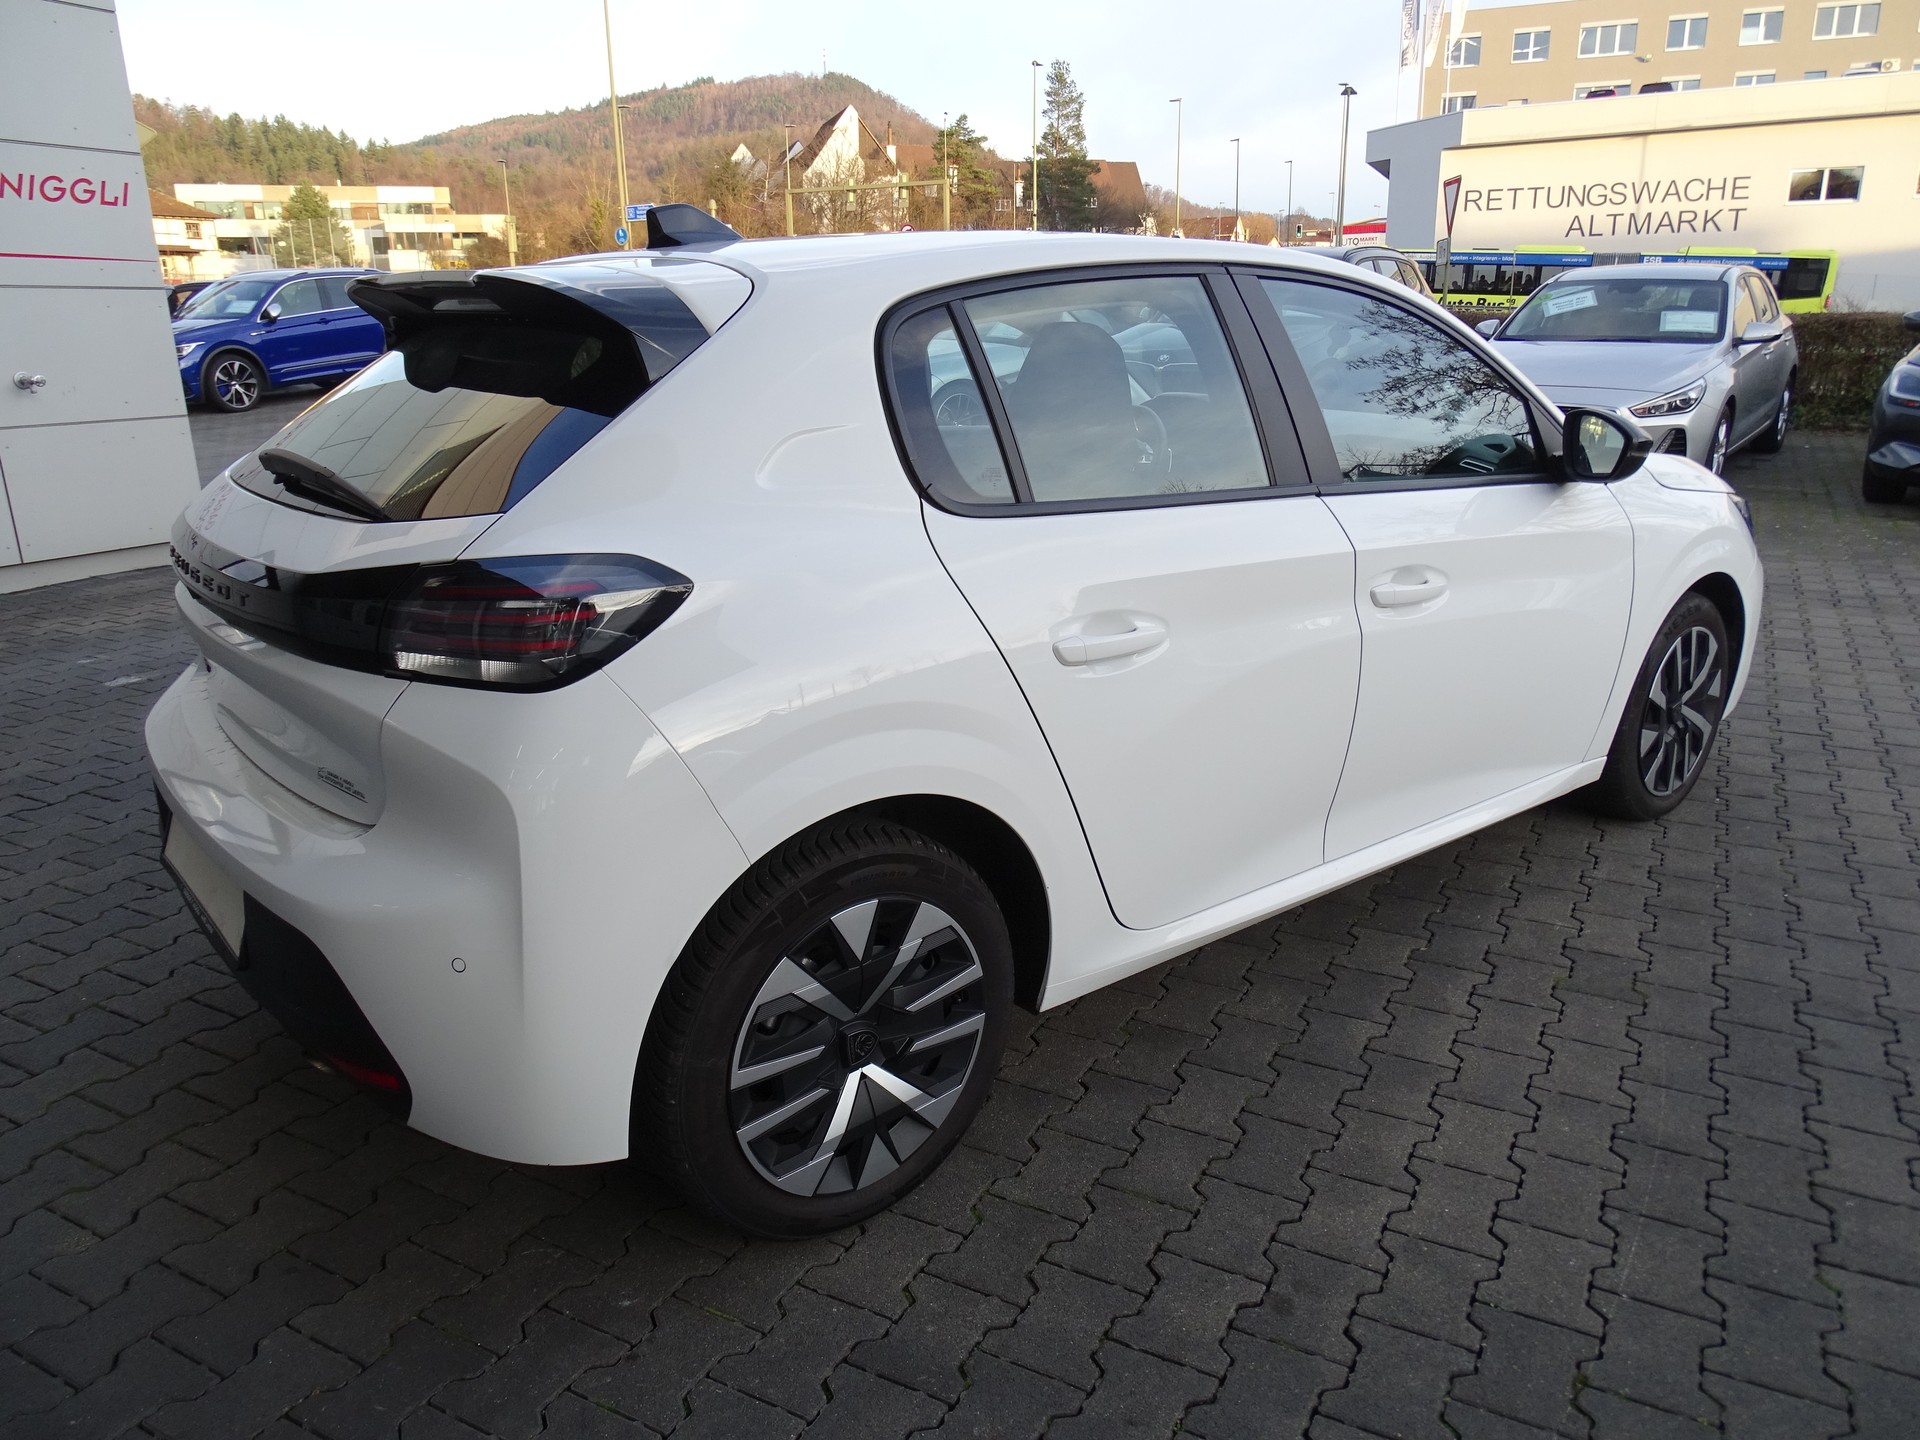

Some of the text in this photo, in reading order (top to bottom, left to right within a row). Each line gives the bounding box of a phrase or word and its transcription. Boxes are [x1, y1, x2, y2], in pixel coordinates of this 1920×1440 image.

[0, 172, 129, 207] NIGGLI
[1464, 176, 1751, 212] RETTUNGSWACHE
[1565, 208, 1748, 238] ALTMARKT
[1342, 237, 1359, 246] UTO
[1643, 256, 1662, 264] ESB
